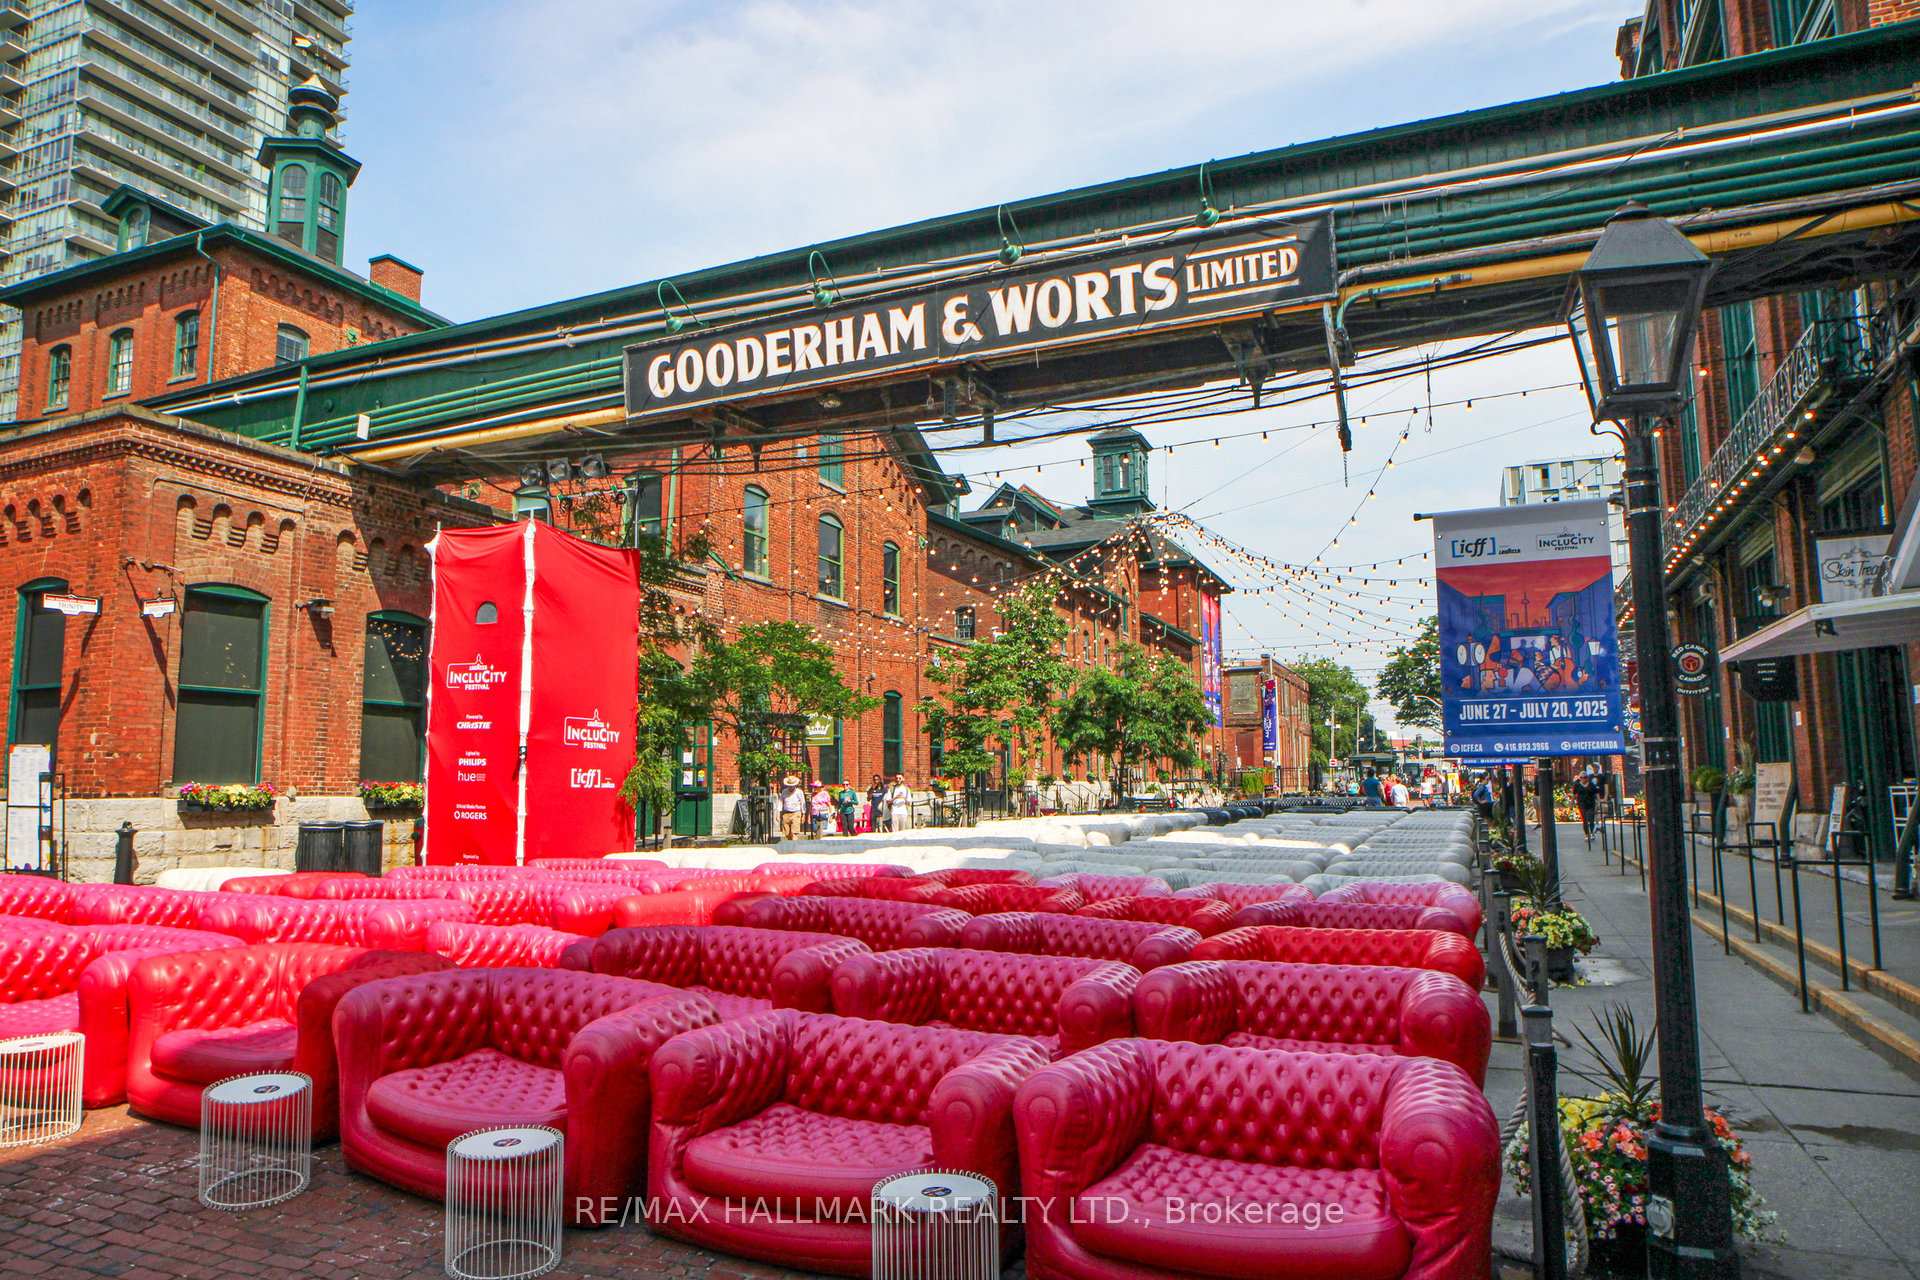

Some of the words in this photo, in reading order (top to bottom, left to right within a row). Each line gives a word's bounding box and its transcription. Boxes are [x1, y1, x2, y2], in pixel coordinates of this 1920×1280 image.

[648, 303, 927, 399] GOODERHAM
[942, 294, 984, 345] &
[987, 254, 1178, 337] WORTS
[1186, 247, 1299, 294] LIMITED
[1459, 704, 1490, 721] JUNE
[1493, 703, 1507, 719] 27
[1520, 702, 1549, 719] JULY
[1552, 701, 1572, 719] 20,
[1575, 700, 1608, 717] 2025
[583, 741, 607, 750] FESTIVAL
[458, 758, 487, 766] PHILIPS
[457, 770, 476, 782] hue
[461, 811, 488, 820] ROGERS
